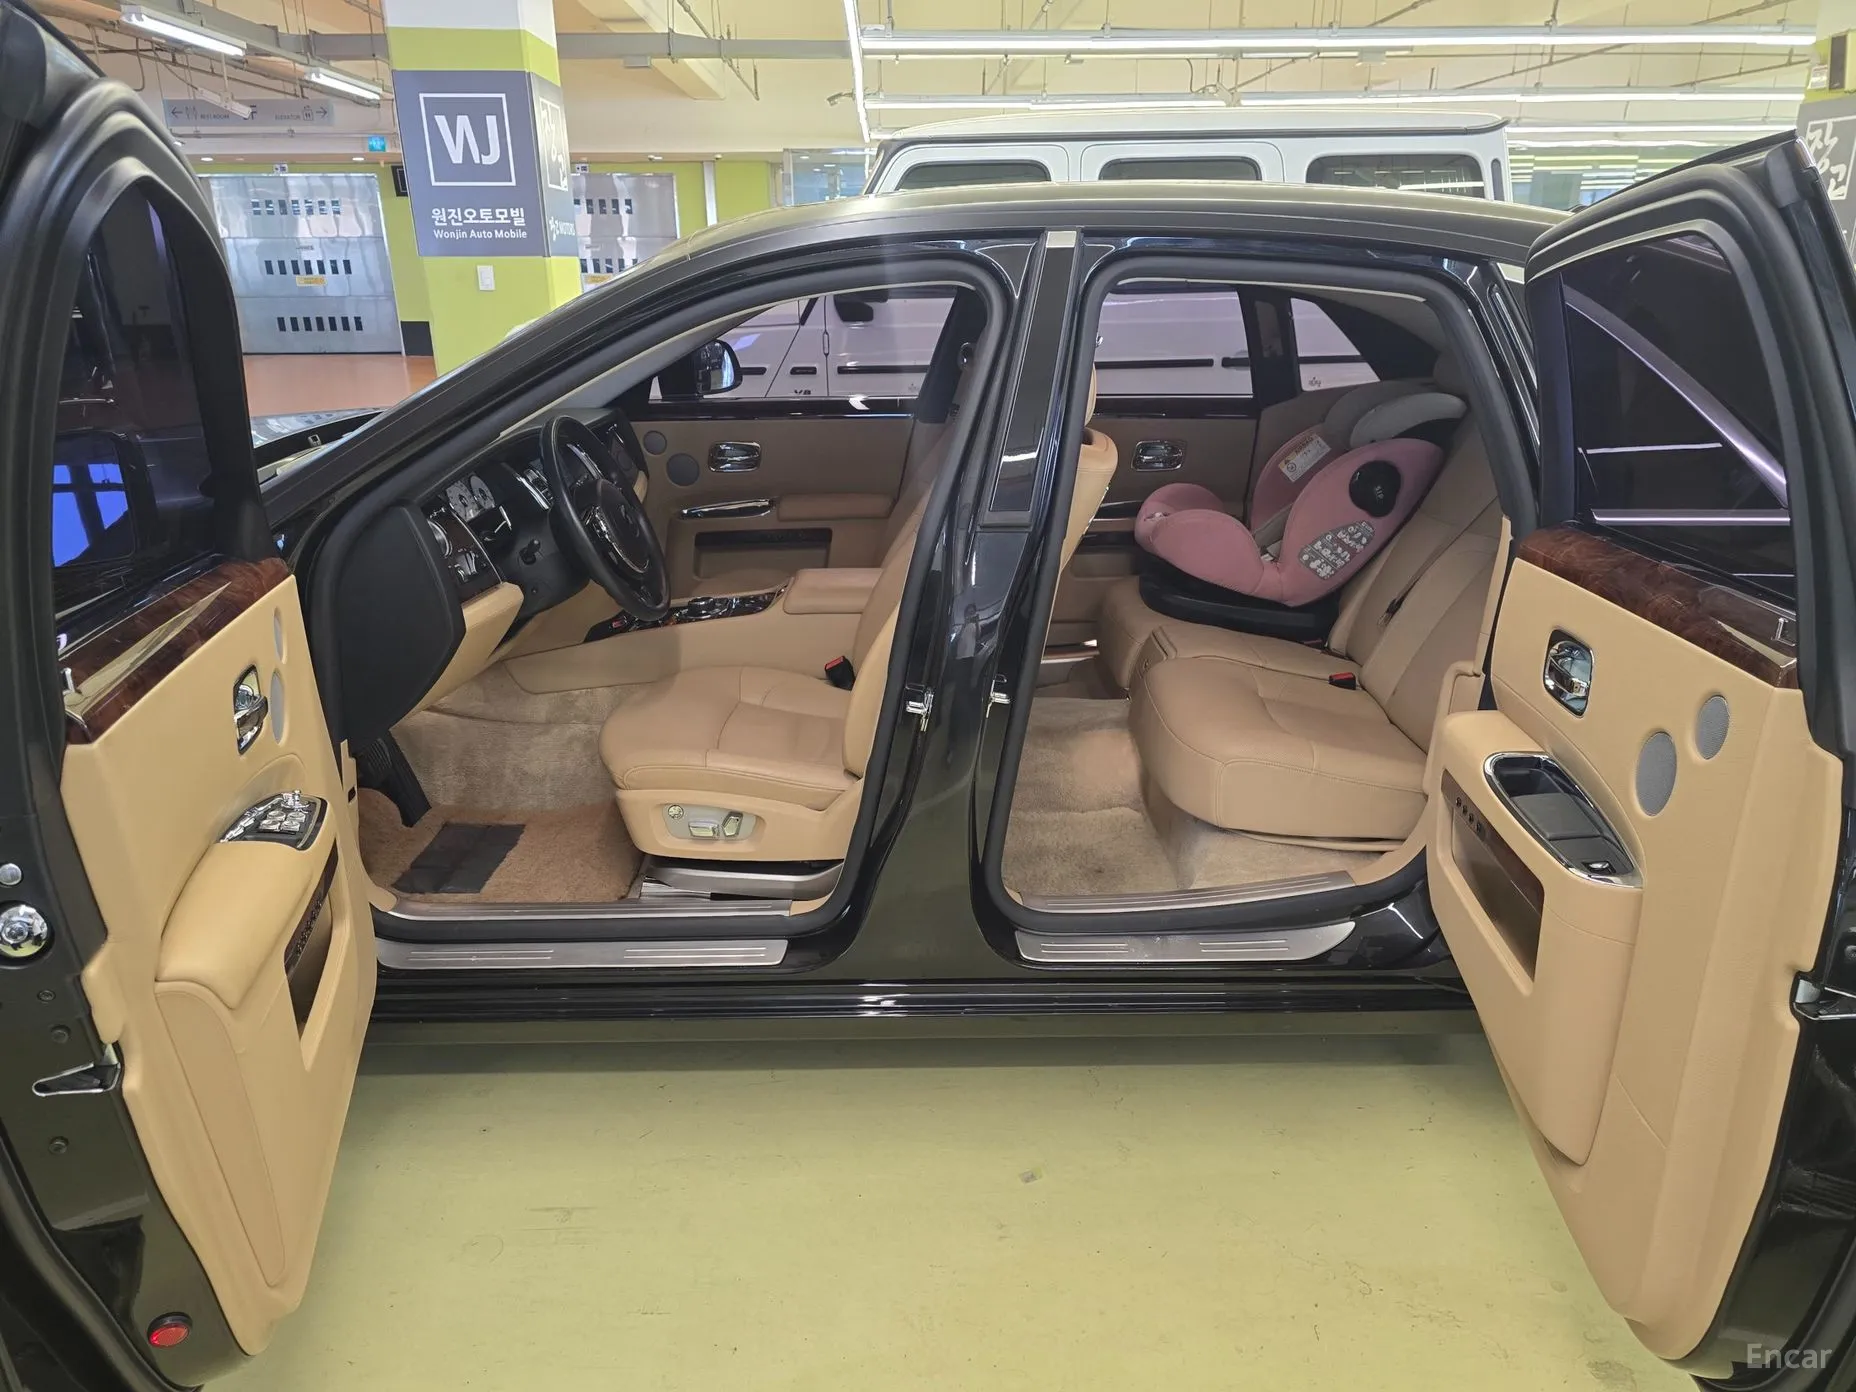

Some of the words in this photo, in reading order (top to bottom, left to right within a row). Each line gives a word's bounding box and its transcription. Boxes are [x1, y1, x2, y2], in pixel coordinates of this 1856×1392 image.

[434, 114, 501, 165] WJ
[432, 207, 526, 226] 원진오토모빌
[434, 229, 468, 240] Wonjin
[470, 229, 493, 239] Auto
[494, 229, 527, 239] Mobile
